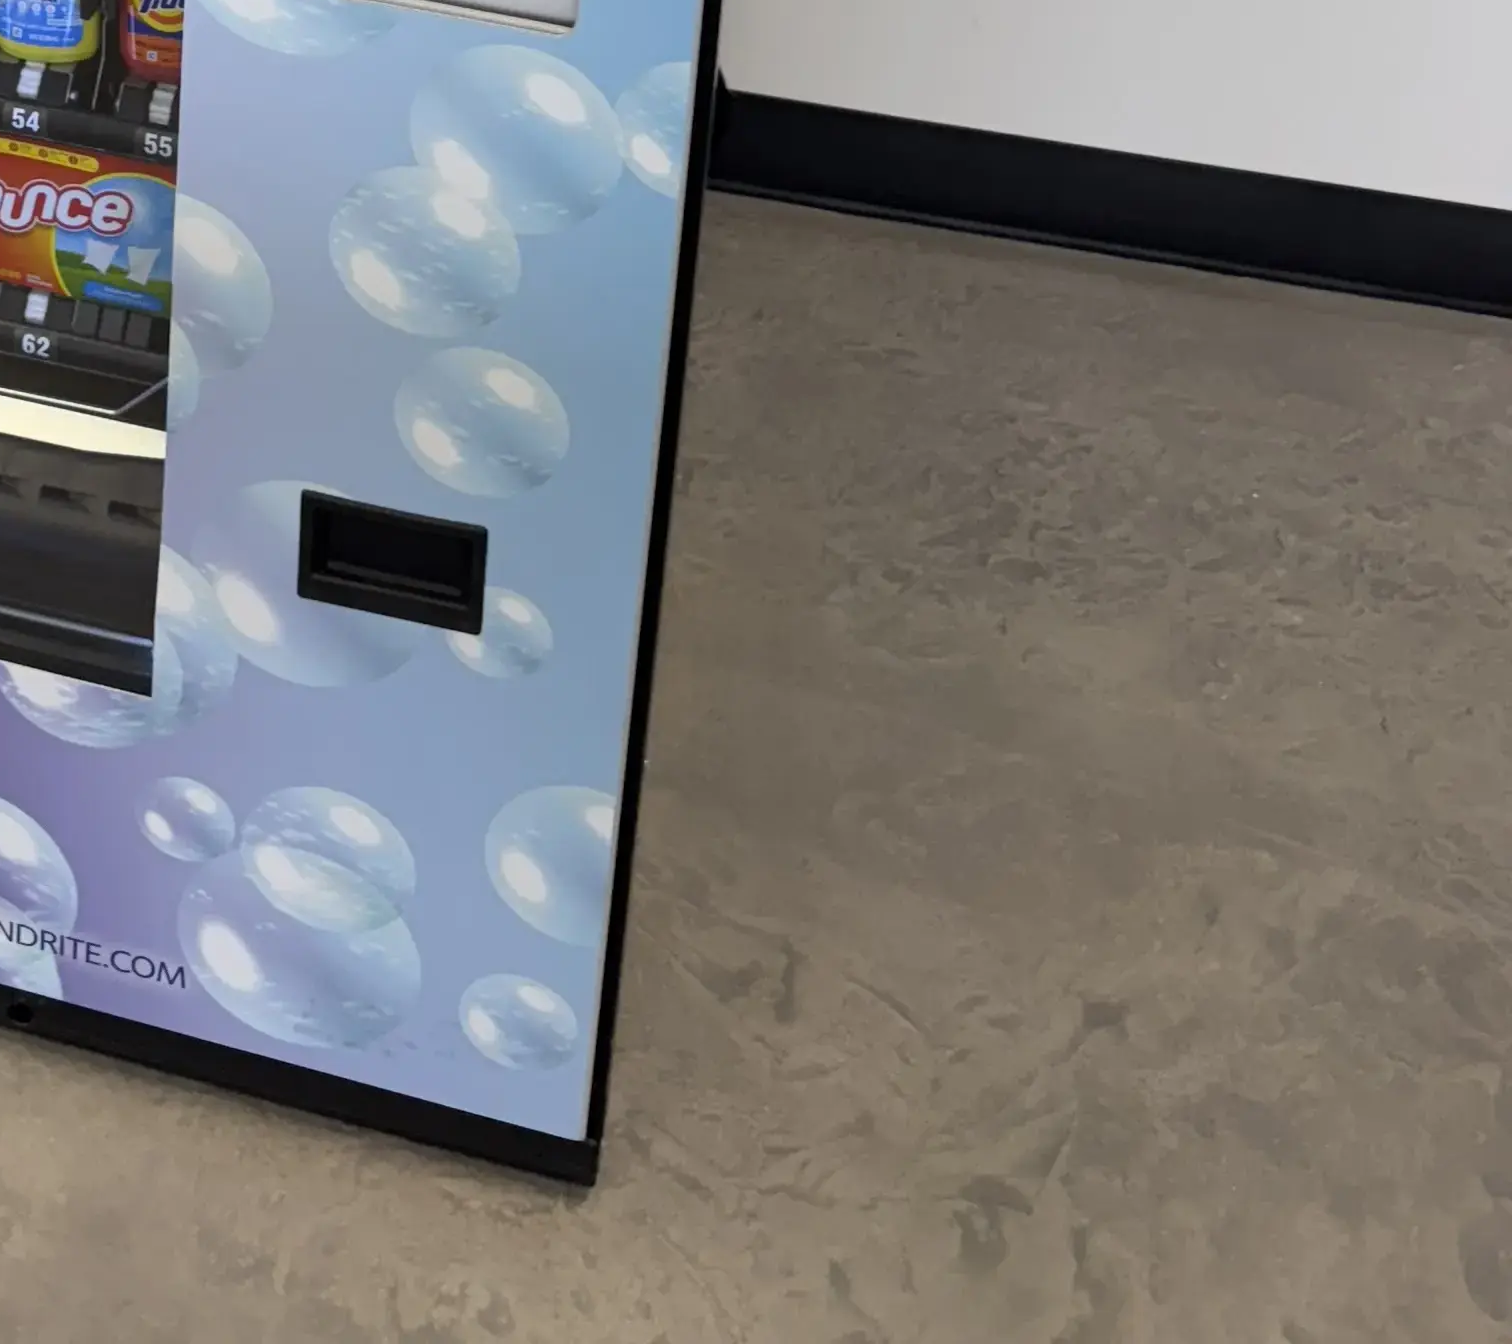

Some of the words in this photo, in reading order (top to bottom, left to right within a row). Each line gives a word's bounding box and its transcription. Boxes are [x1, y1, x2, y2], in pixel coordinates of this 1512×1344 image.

[12, 108, 40, 132] 54
[144, 133, 173, 157] 55
[22, 333, 51, 357] 62
